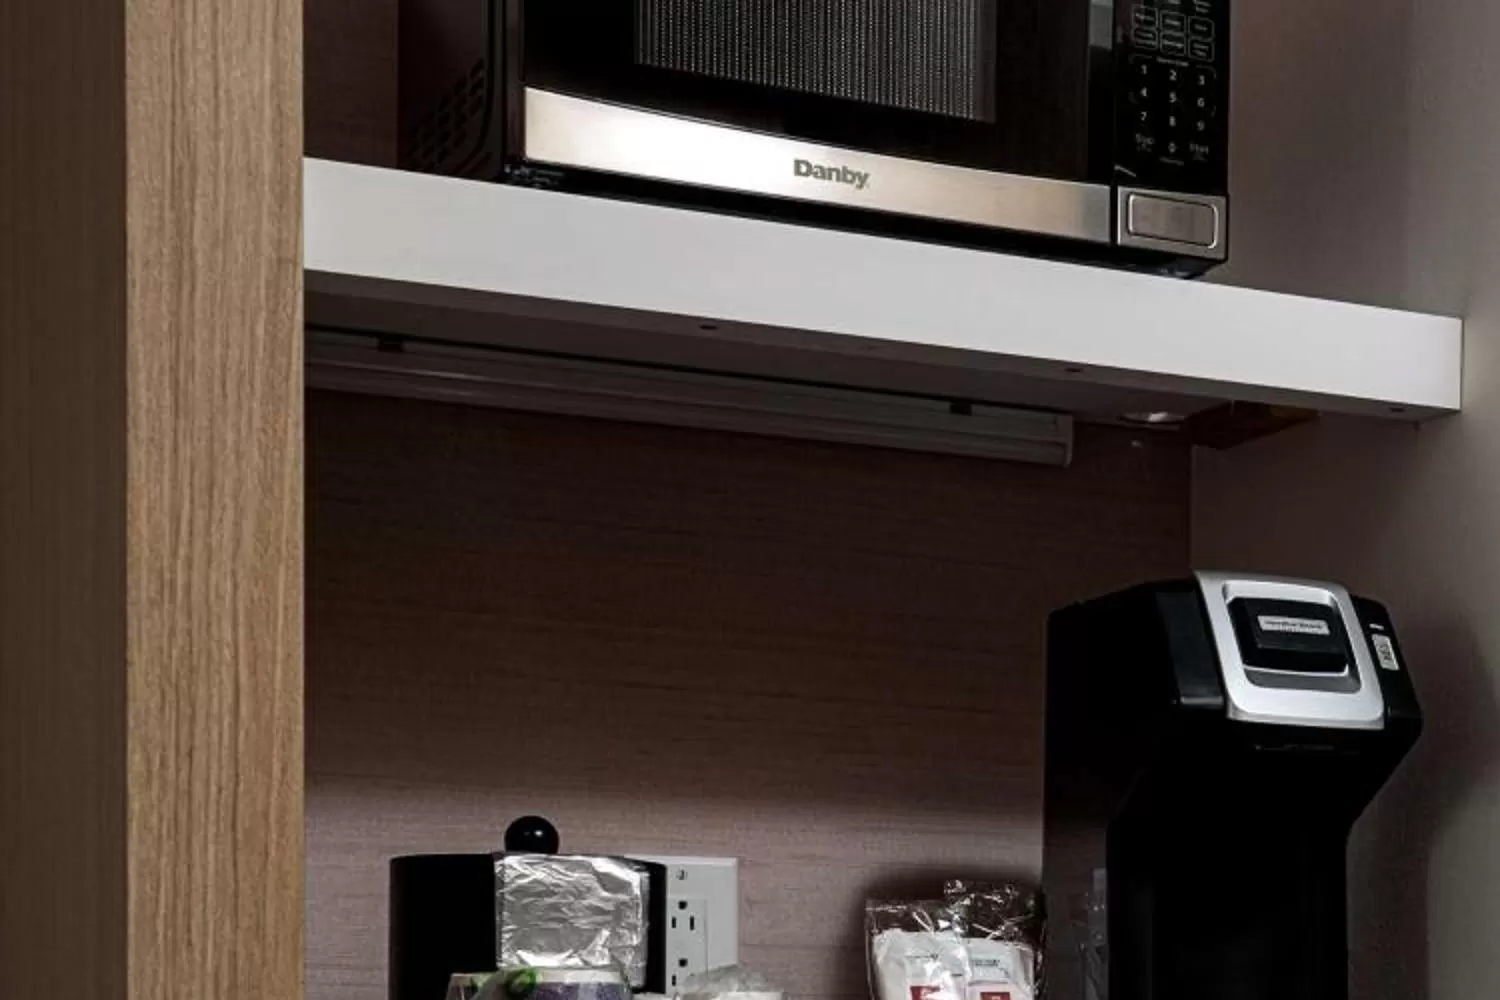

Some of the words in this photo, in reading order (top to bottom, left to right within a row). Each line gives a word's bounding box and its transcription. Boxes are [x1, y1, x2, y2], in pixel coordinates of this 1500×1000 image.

[1169, 68, 1177, 81] 2
[1169, 91, 1177, 103] 5
[1197, 97, 1205, 108] 6
[1196, 120, 1205, 131] 9
[793, 158, 870, 190] Danby
